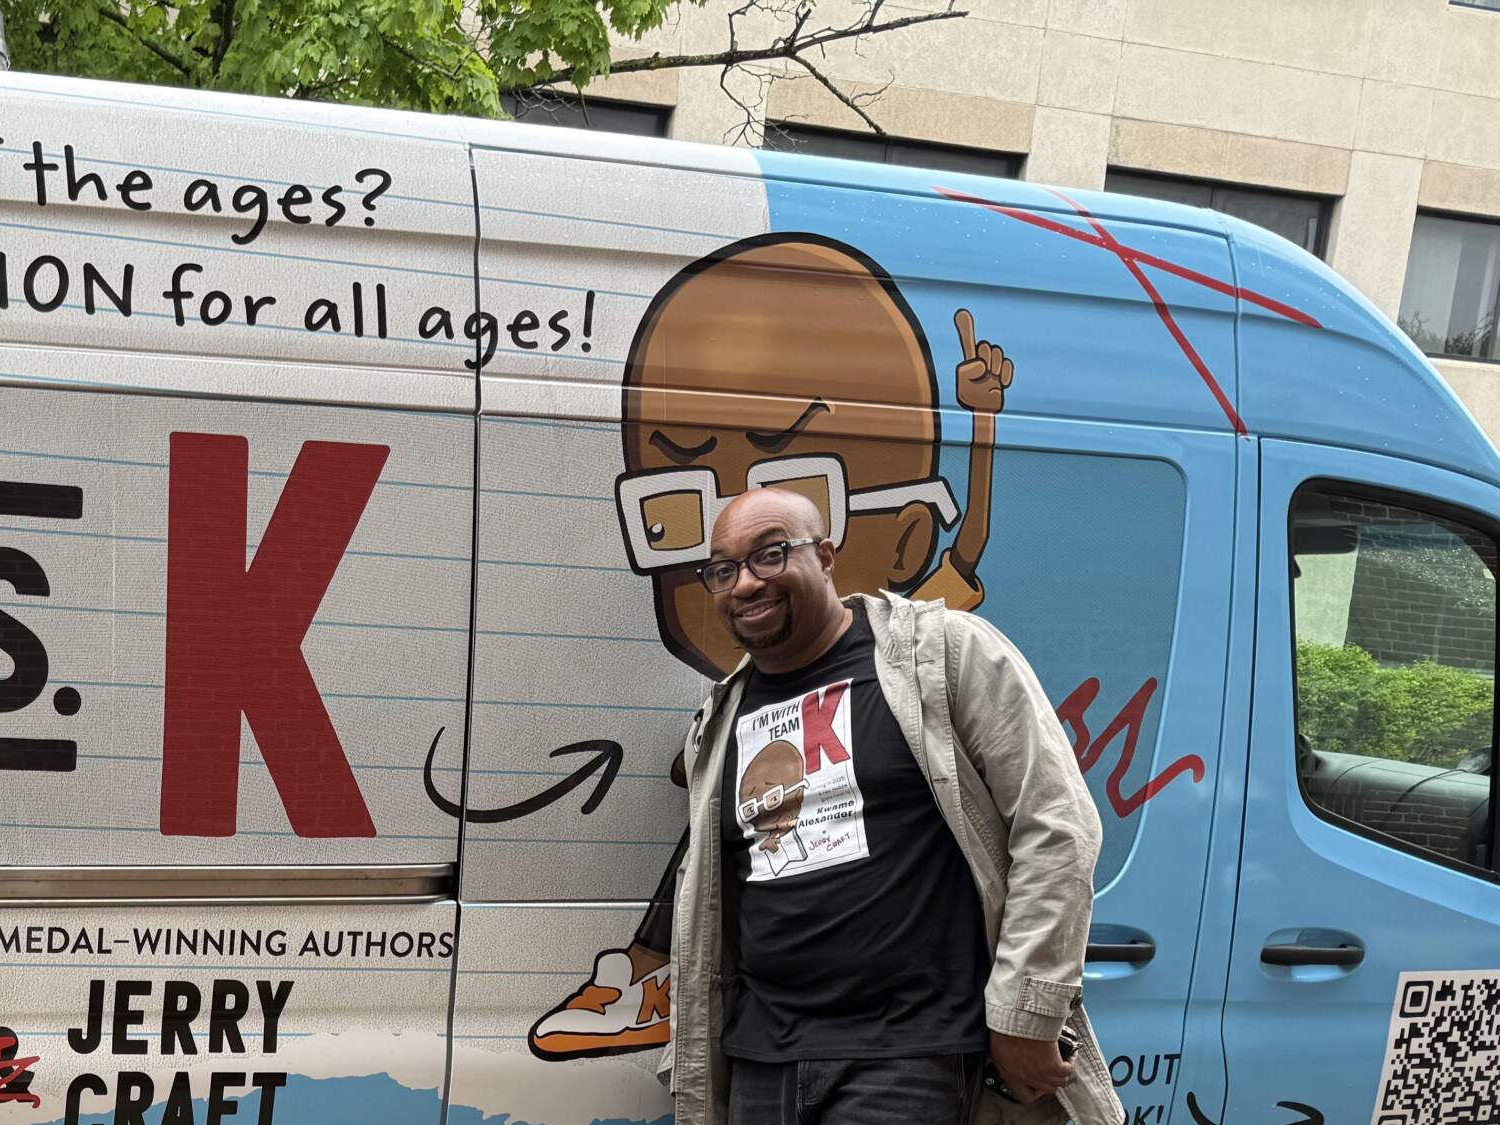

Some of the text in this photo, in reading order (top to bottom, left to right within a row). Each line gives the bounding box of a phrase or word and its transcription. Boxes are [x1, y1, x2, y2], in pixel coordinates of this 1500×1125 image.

[24, 141, 153, 211] the
[183, 168, 392, 244] ages?
[163, 264, 277, 326] for
[304, 282, 387, 339] all
[418, 291, 595, 369] ages!
[160, 431, 390, 838] K
[752, 701, 800, 731] I'M WITH
[769, 717, 800, 740] TEAM
[801, 681, 851, 775] K
[798, 810, 853, 829] Alexander
[816, 800, 854, 815] Kwame
[298, 931, 455, 958] AUTHORS
[67, 979, 295, 1055] JERRY
